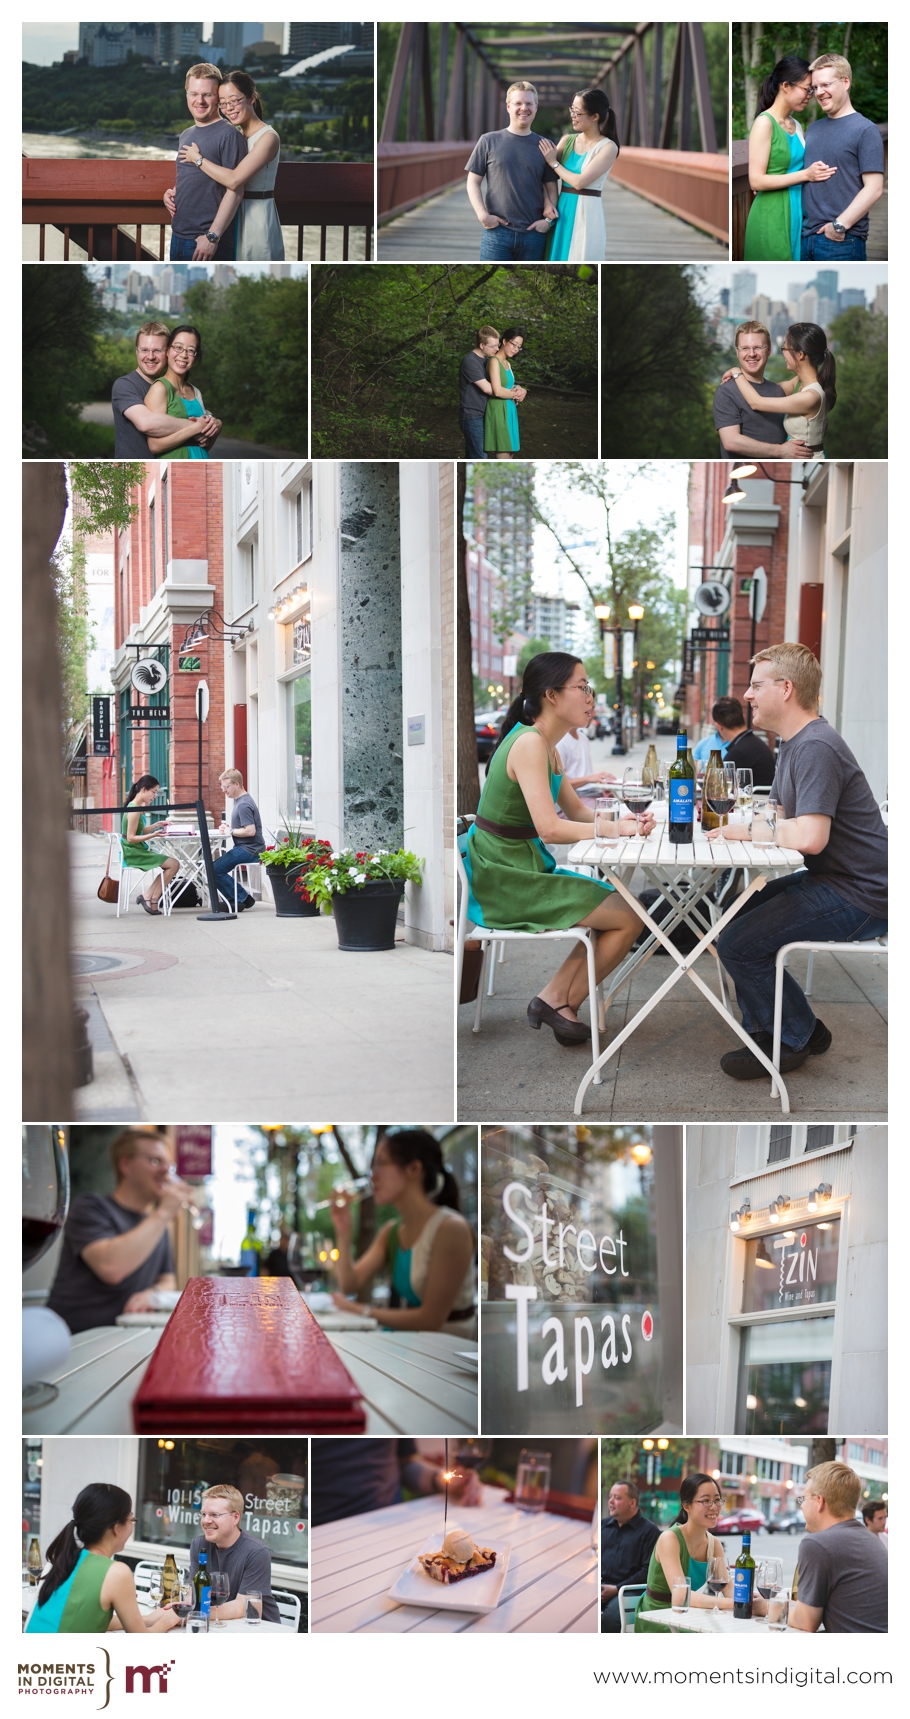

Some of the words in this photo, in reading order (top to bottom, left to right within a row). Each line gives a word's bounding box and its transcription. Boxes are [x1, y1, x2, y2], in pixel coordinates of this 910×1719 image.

[502, 1182, 629, 1277] Street
[785, 1291, 794, 1301] Wine
[805, 1289, 815, 1301] Tapas
[505, 1284, 633, 1407] Tapas
[245, 1493, 292, 1512] Street
[168, 1505, 201, 1525] Wine
[245, 1511, 290, 1539] Tapas
